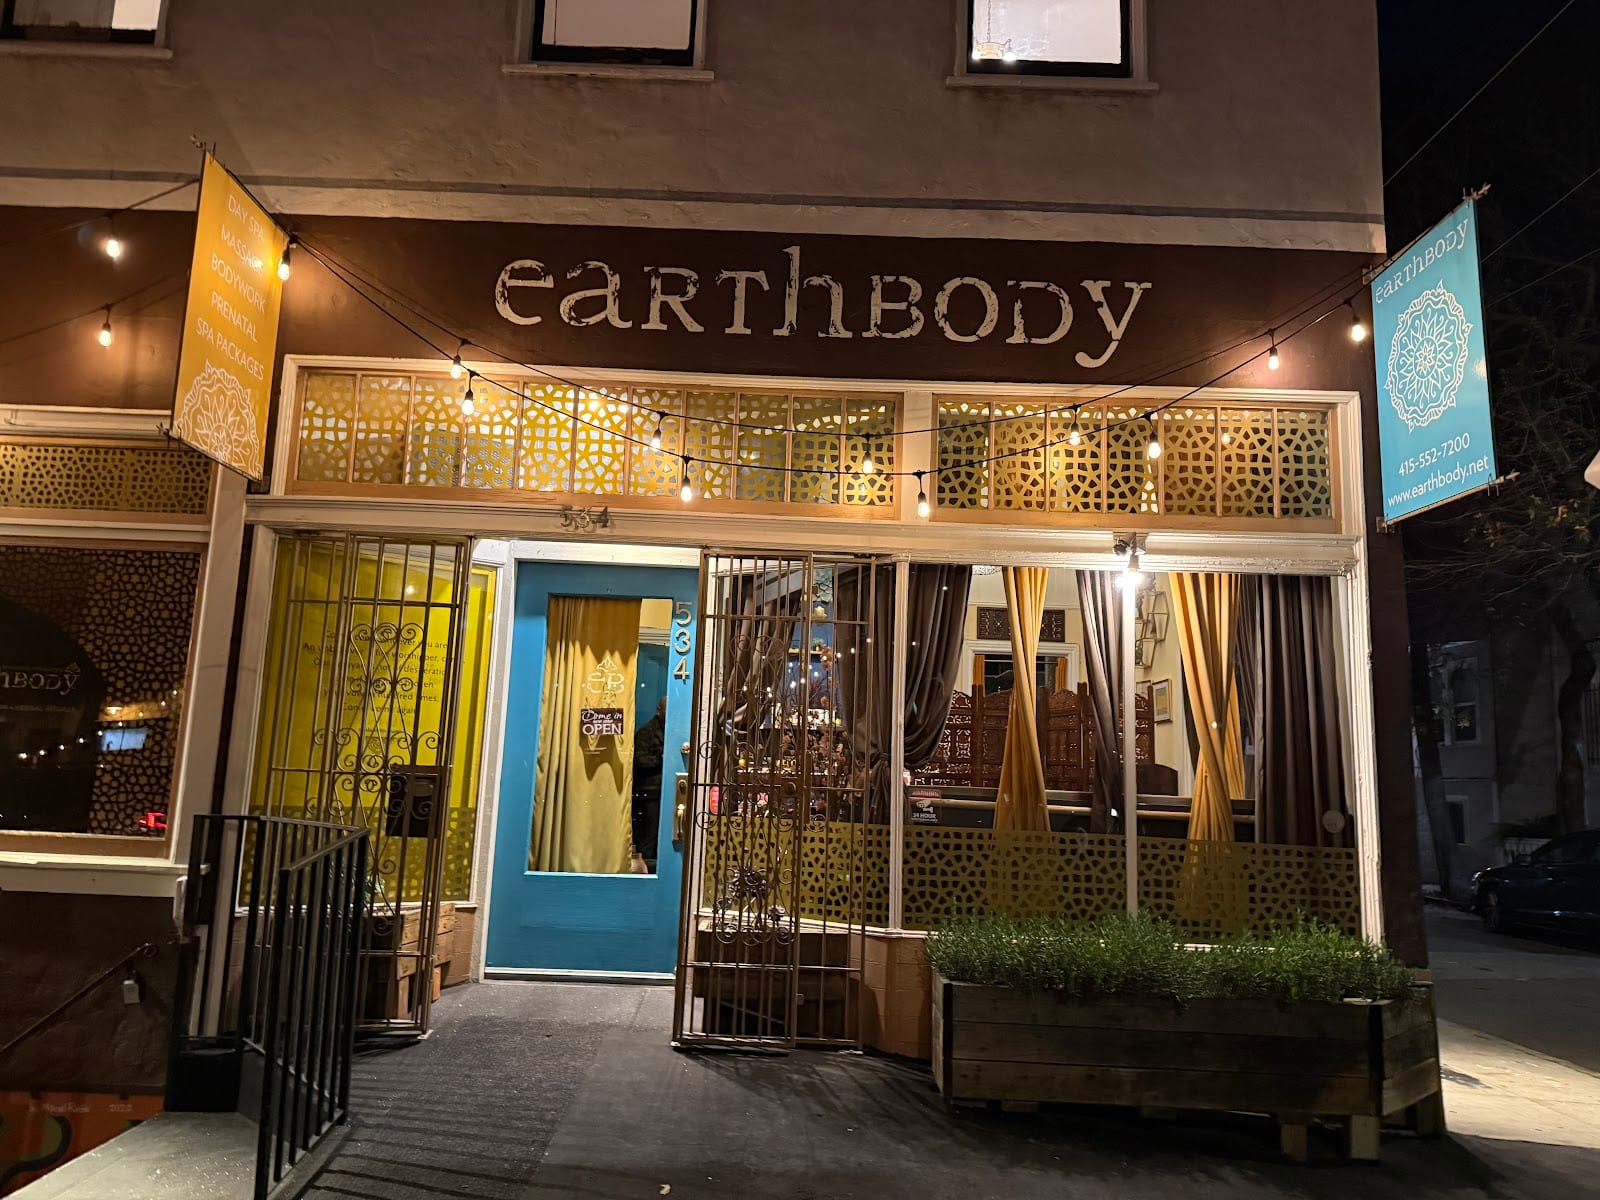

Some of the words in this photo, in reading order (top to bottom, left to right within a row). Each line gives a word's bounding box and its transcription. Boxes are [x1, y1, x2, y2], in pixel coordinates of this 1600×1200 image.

[228, 194, 249, 222] DAY
[249, 214, 265, 241] SPA
[211, 253, 266, 313] BODYWORK
[211, 290, 258, 343] PRENATAL
[197, 316, 215, 345] SPA
[216, 333, 265, 381] PACKAGES
[1398, 432, 1471, 477] 415-552-7200
[1387, 455, 1489, 508] www.earthbody.net
[672, 601, 693, 681] 534
[581, 709, 612, 722] Come
[582, 723, 623, 735] OPEN
